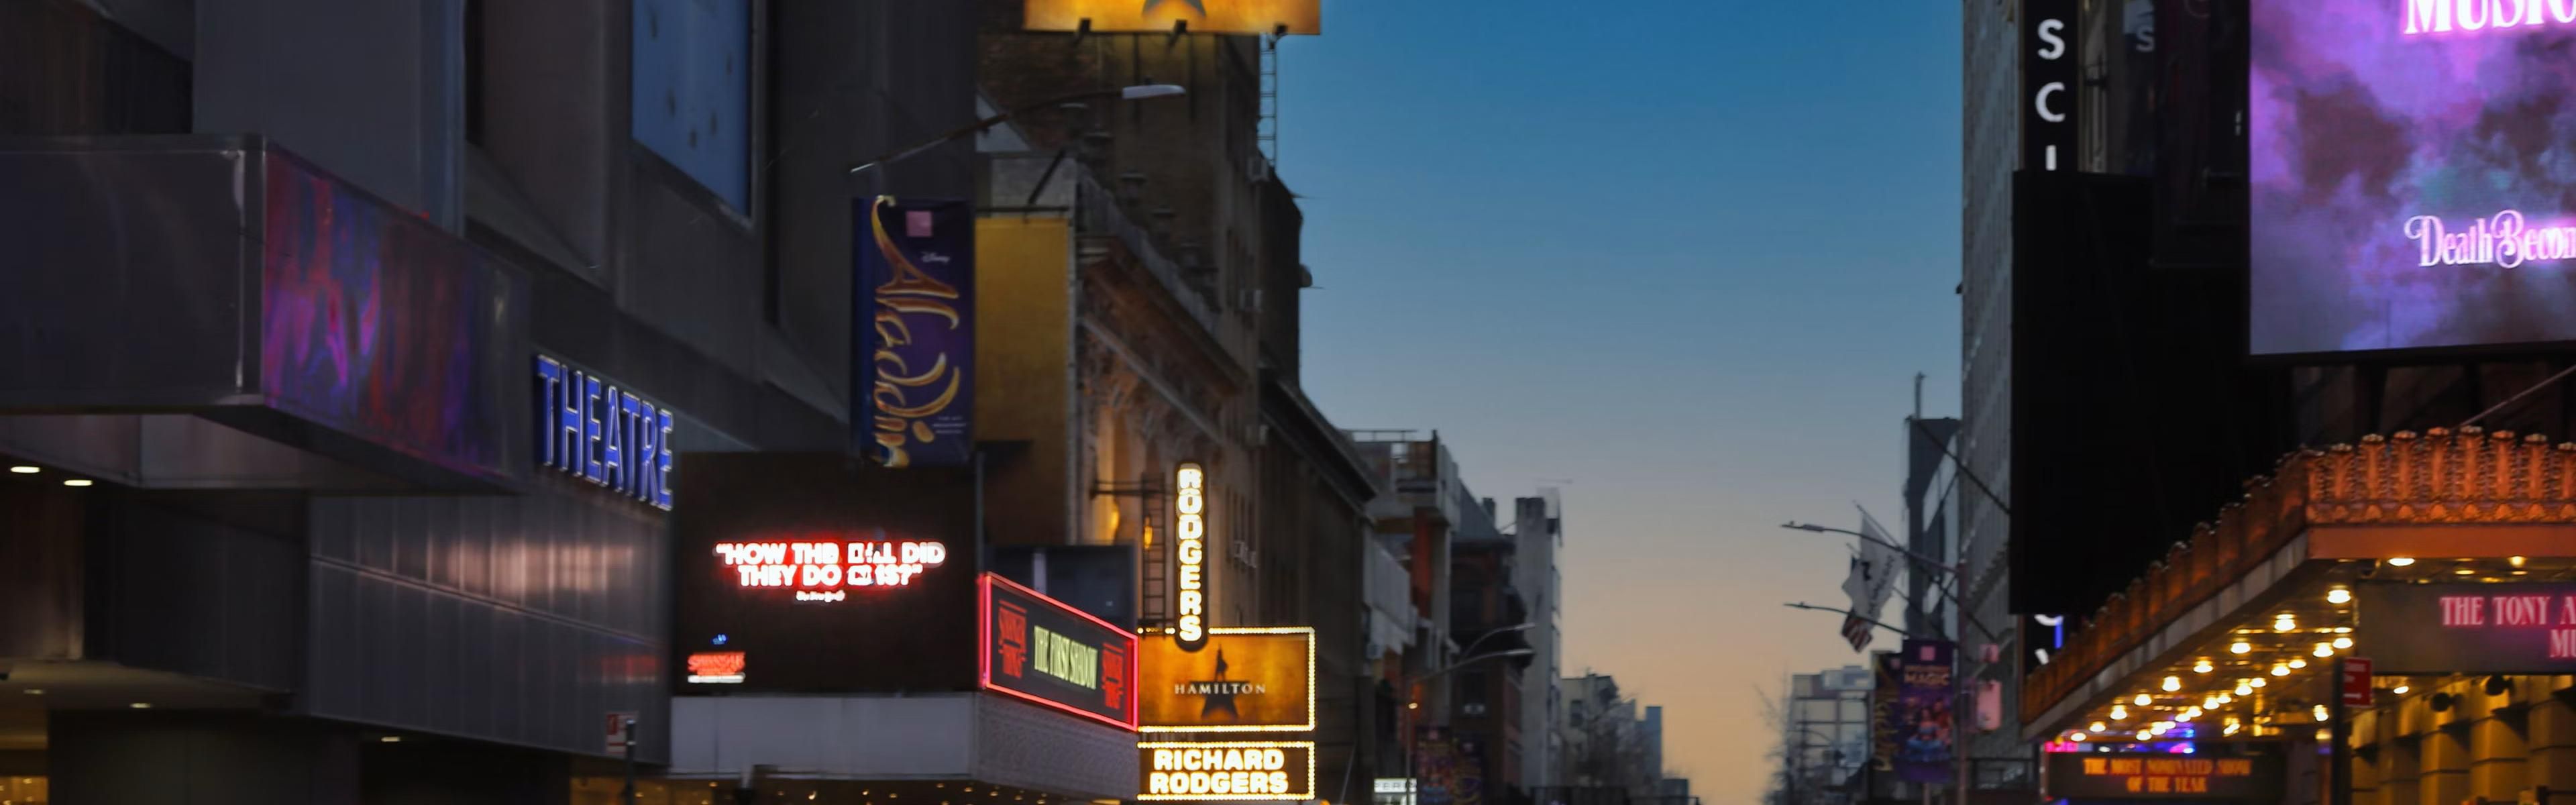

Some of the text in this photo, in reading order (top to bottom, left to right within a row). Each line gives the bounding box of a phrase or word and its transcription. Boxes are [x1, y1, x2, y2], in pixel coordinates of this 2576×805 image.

[2404, 215, 2493, 266] Death
[538, 354, 673, 511] THEATRE
[902, 542, 946, 564] DID
[1179, 463, 1203, 641] RODGERS
[737, 564, 797, 586] THEY
[802, 564, 842, 586] DO
[2440, 596, 2483, 625] THE
[2492, 596, 2550, 625] TONY
[1175, 683, 1267, 695] HAMILTON
[1153, 749, 1284, 771] RICHARD
[1149, 771, 1289, 794] RODGERS
